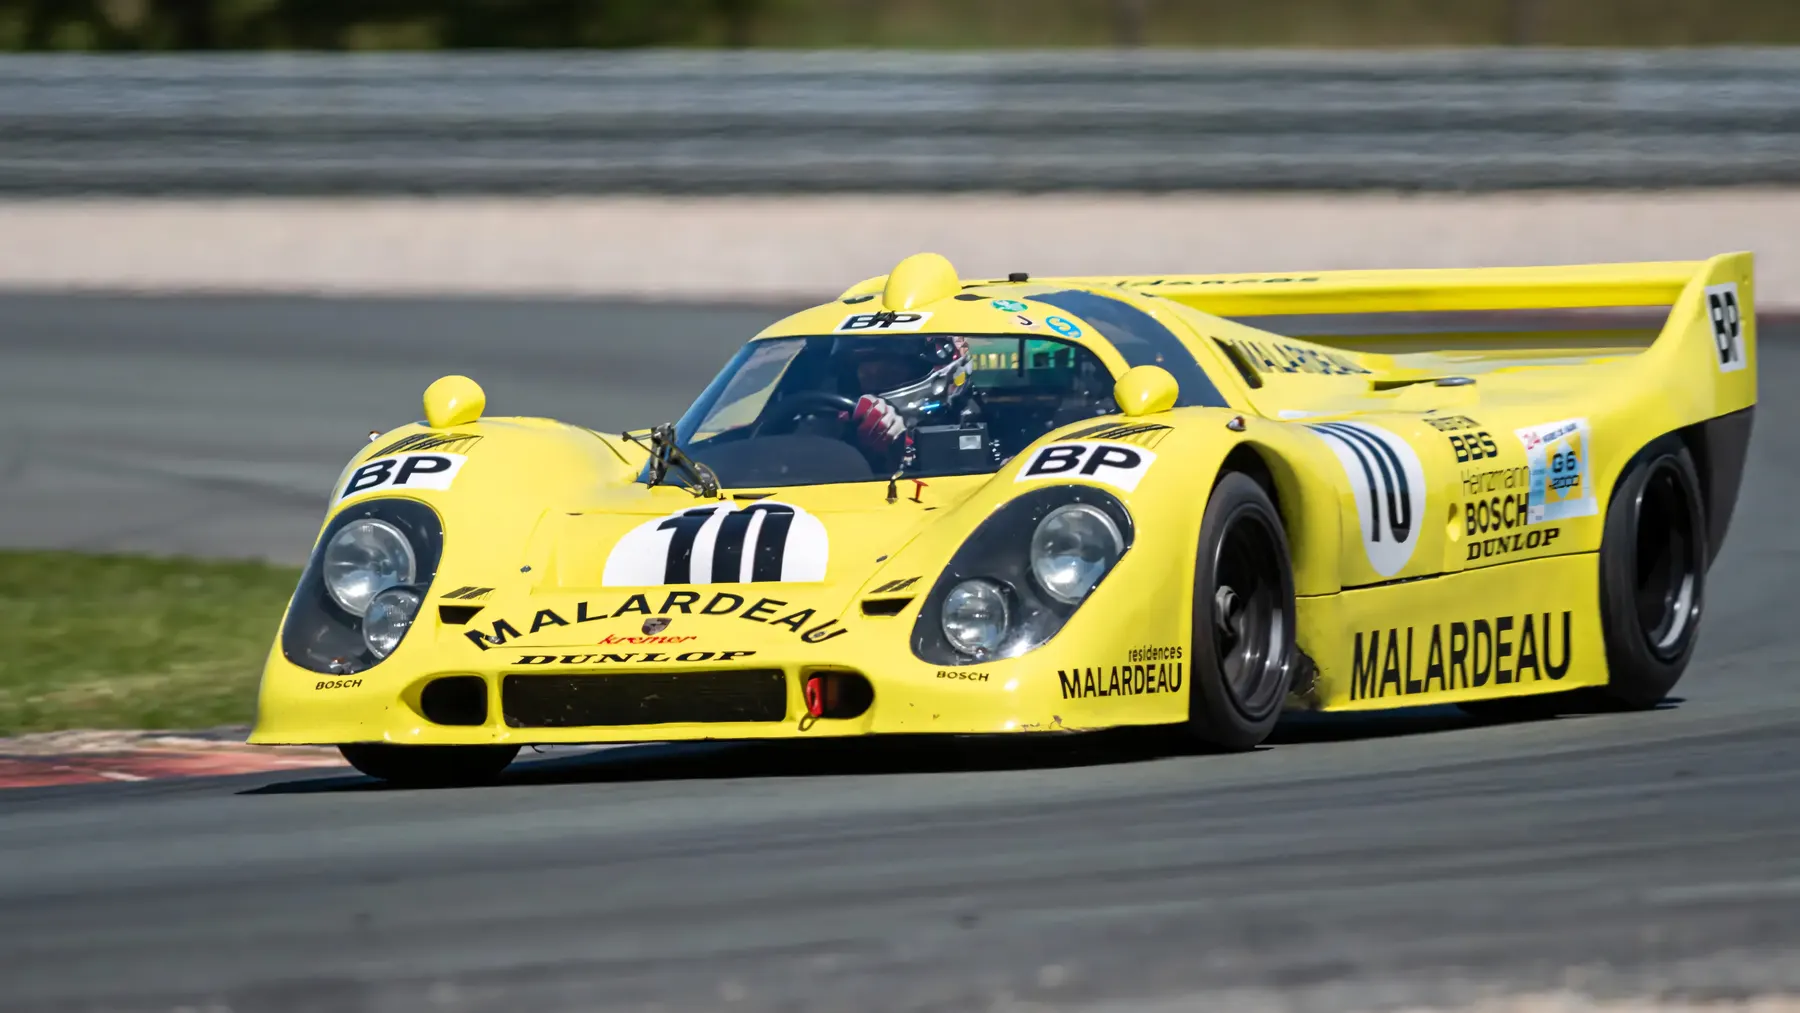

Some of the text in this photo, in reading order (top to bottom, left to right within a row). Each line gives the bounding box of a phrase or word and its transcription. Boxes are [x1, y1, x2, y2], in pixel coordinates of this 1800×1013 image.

[840, 312, 922, 330] BP
[1708, 291, 1740, 364] BP
[1025, 445, 1142, 477] BP
[1449, 431, 1498, 463] BBS
[1552, 451, 1577, 473] G6
[341, 456, 452, 499] BP
[1303, 422, 1411, 543] 10
[1461, 466, 1530, 497] Heinzmann
[1465, 492, 1530, 536] BOSCH
[656, 503, 795, 585] 10
[1466, 527, 1560, 560] DUNLOP
[463, 590, 848, 652] MALARDEAU
[597, 633, 698, 646] kremer
[1350, 610, 1572, 701] MALARDEAU
[511, 650, 757, 666] DUNLOP
[315, 679, 364, 690] BOSCH
[936, 670, 990, 682] BOSCH
[1057, 662, 1183, 700] MALARDEAU
